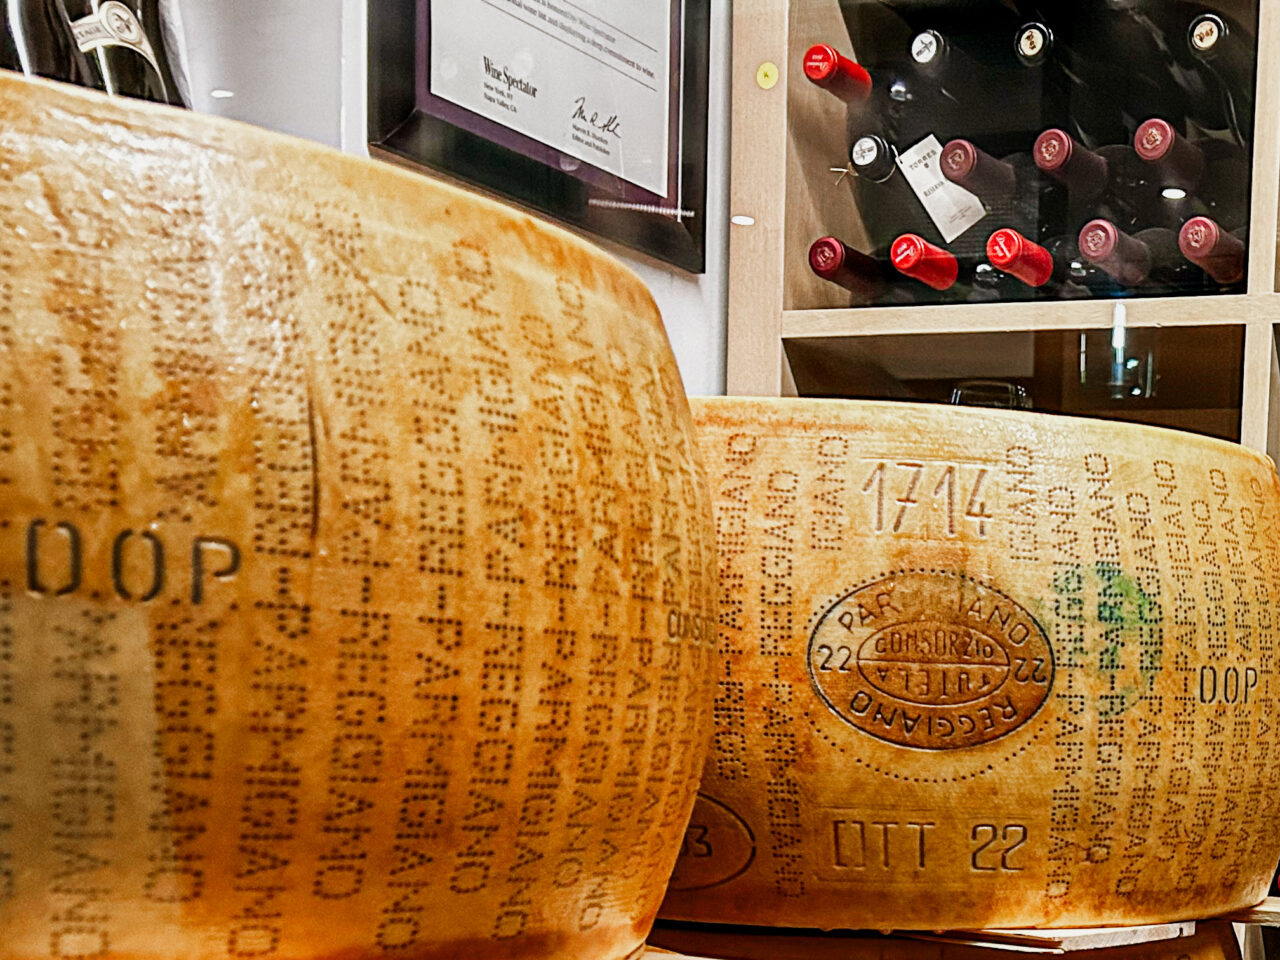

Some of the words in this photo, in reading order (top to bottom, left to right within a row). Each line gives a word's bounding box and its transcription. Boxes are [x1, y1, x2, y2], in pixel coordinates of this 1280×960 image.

[483, 55, 503, 82] Wine
[503, 65, 538, 98] Spectator
[908, 148, 938, 170] TORRES
[862, 461, 994, 539] 1714
[817, 643, 853, 672] 22
[875, 629, 995, 660] CONSORZIO
[1199, 666, 1258, 705] DOP
[850, 690, 1018, 738] REGGIANO
[832, 823, 938, 871] OTT
[970, 823, 1028, 872] 22
